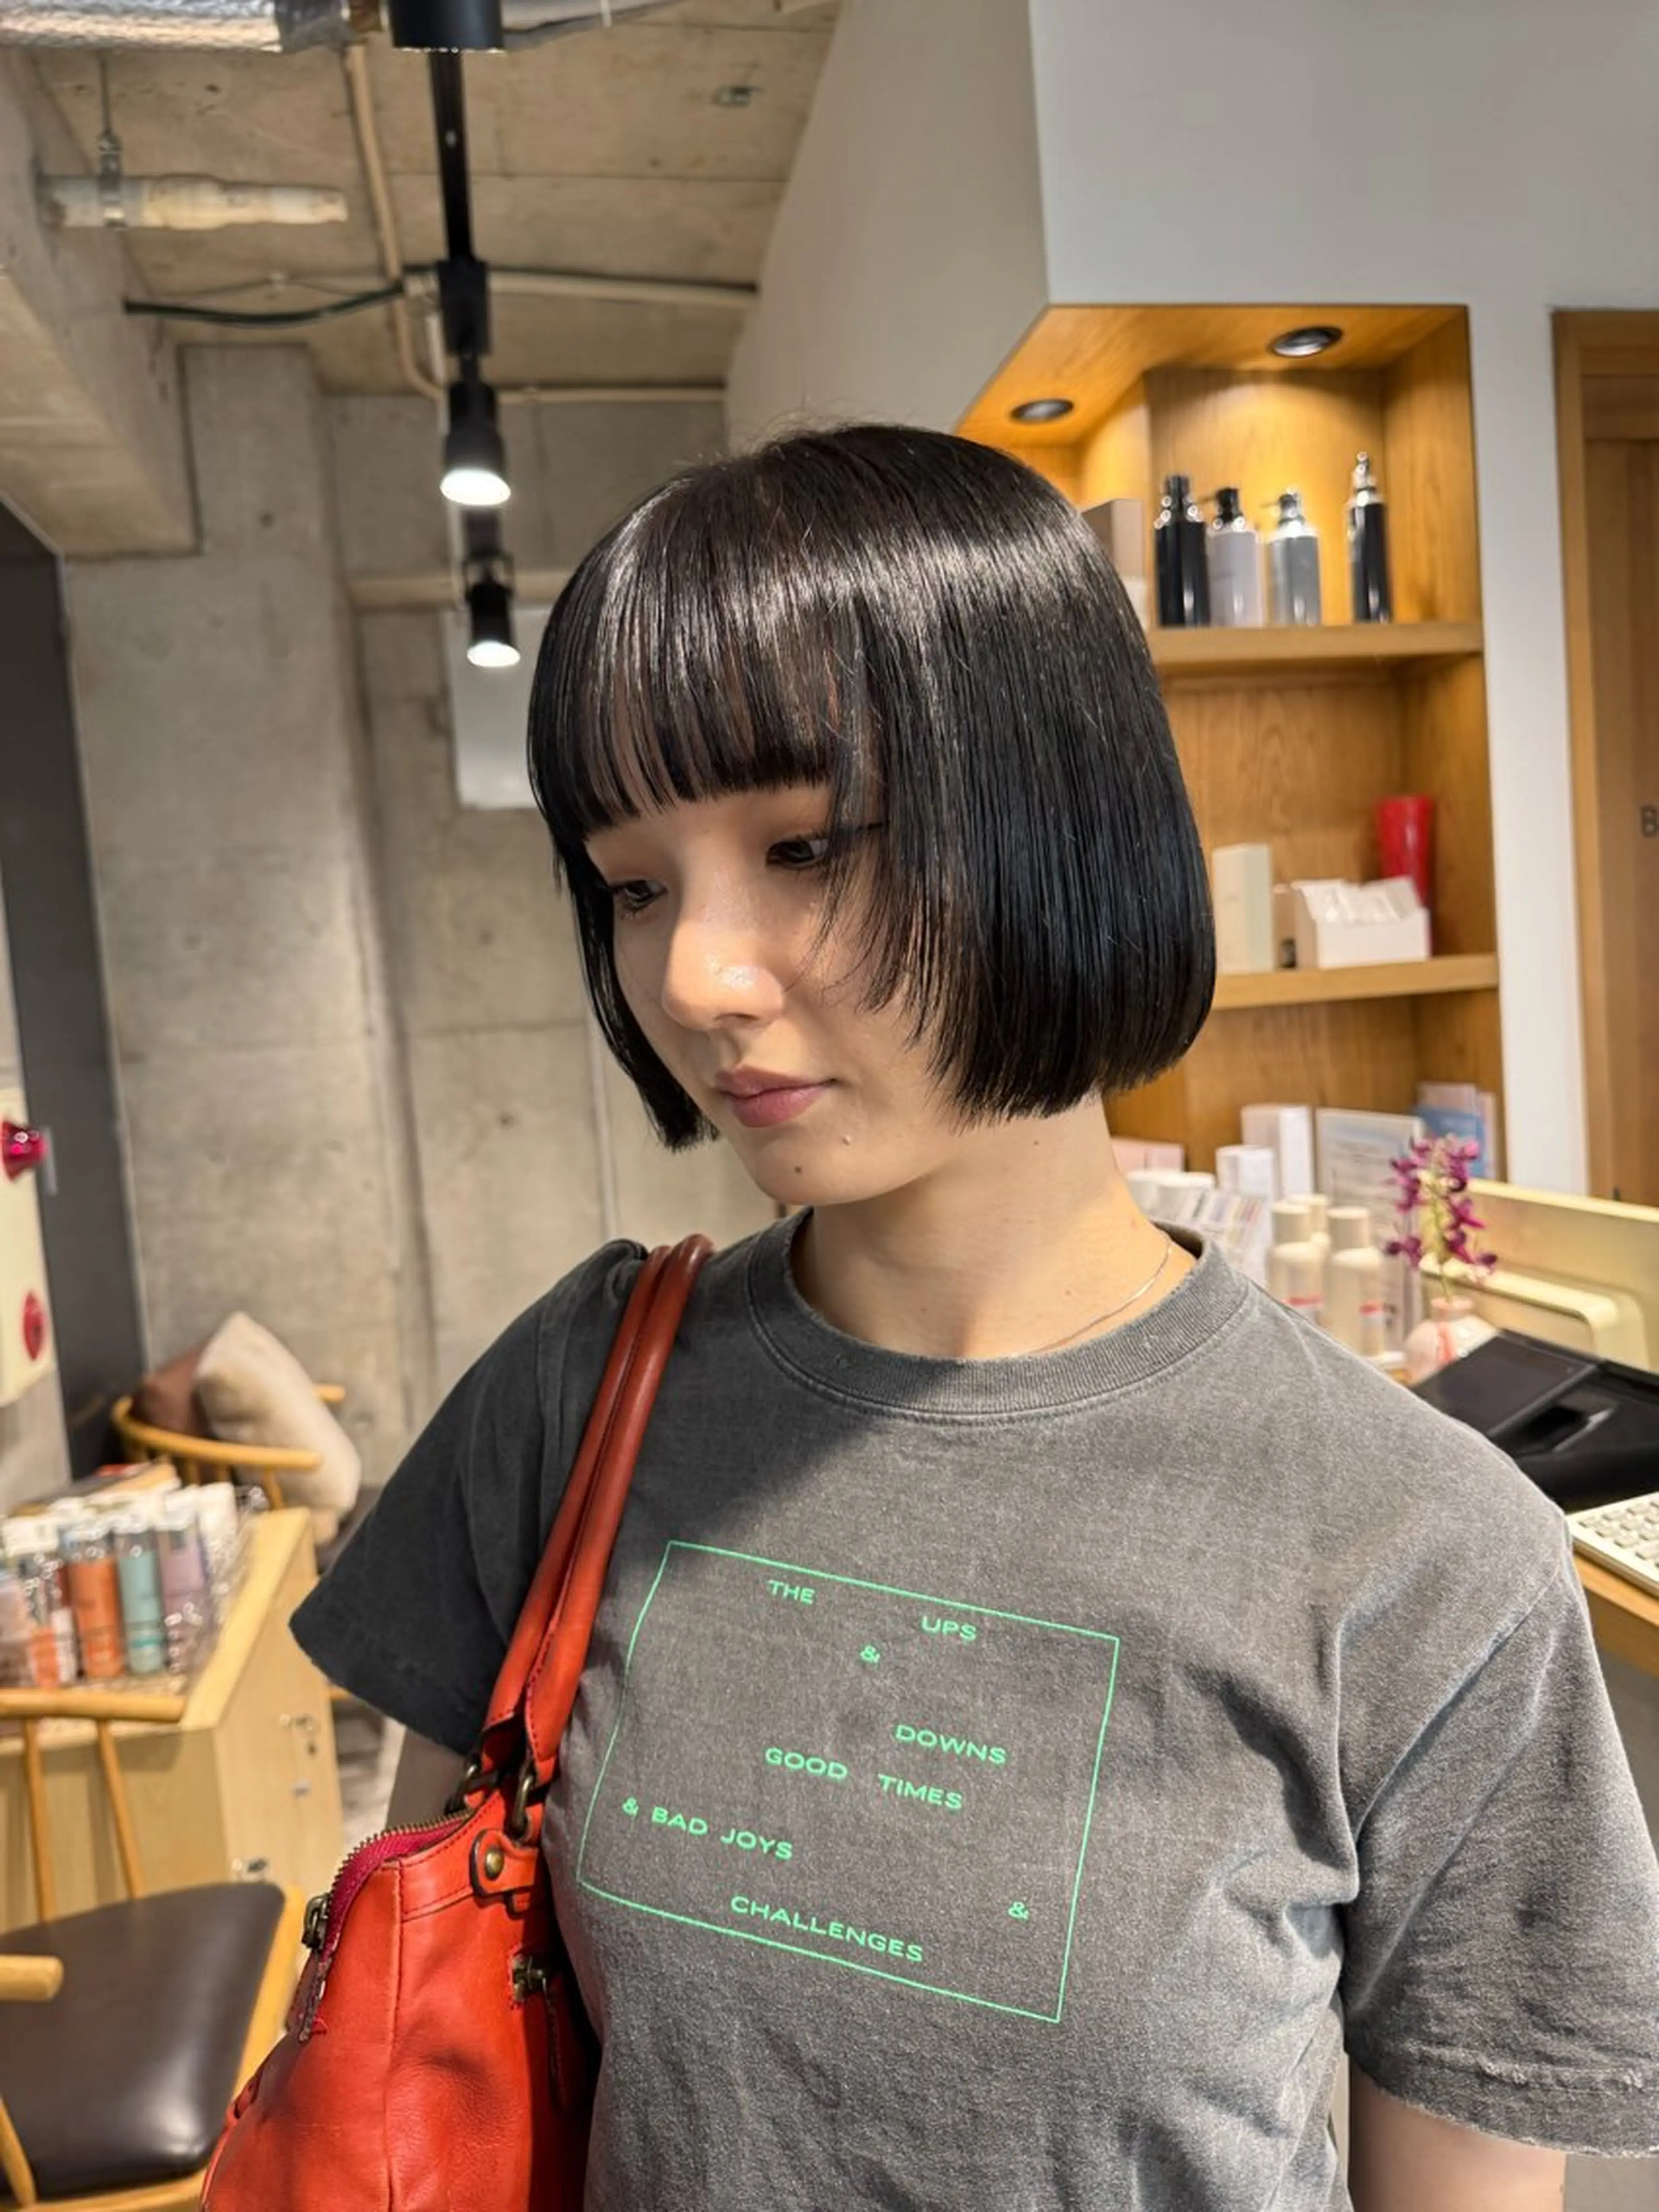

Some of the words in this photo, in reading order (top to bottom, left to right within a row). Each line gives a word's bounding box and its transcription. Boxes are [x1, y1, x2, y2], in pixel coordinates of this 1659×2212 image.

[769, 1579, 815, 1605] THE
[921, 1615, 977, 1642] UPS
[860, 1645, 880, 1664] &
[894, 1724, 1007, 1765] DOWNS
[765, 1747, 849, 1781] GOOD
[879, 1774, 962, 1810] TIMES
[622, 1797, 639, 1816] &
[652, 1806, 708, 1836] BAD
[720, 1828, 793, 1861] JOYS
[1008, 1902, 1029, 1920] &
[730, 1895, 923, 1963] CHALLENGES
